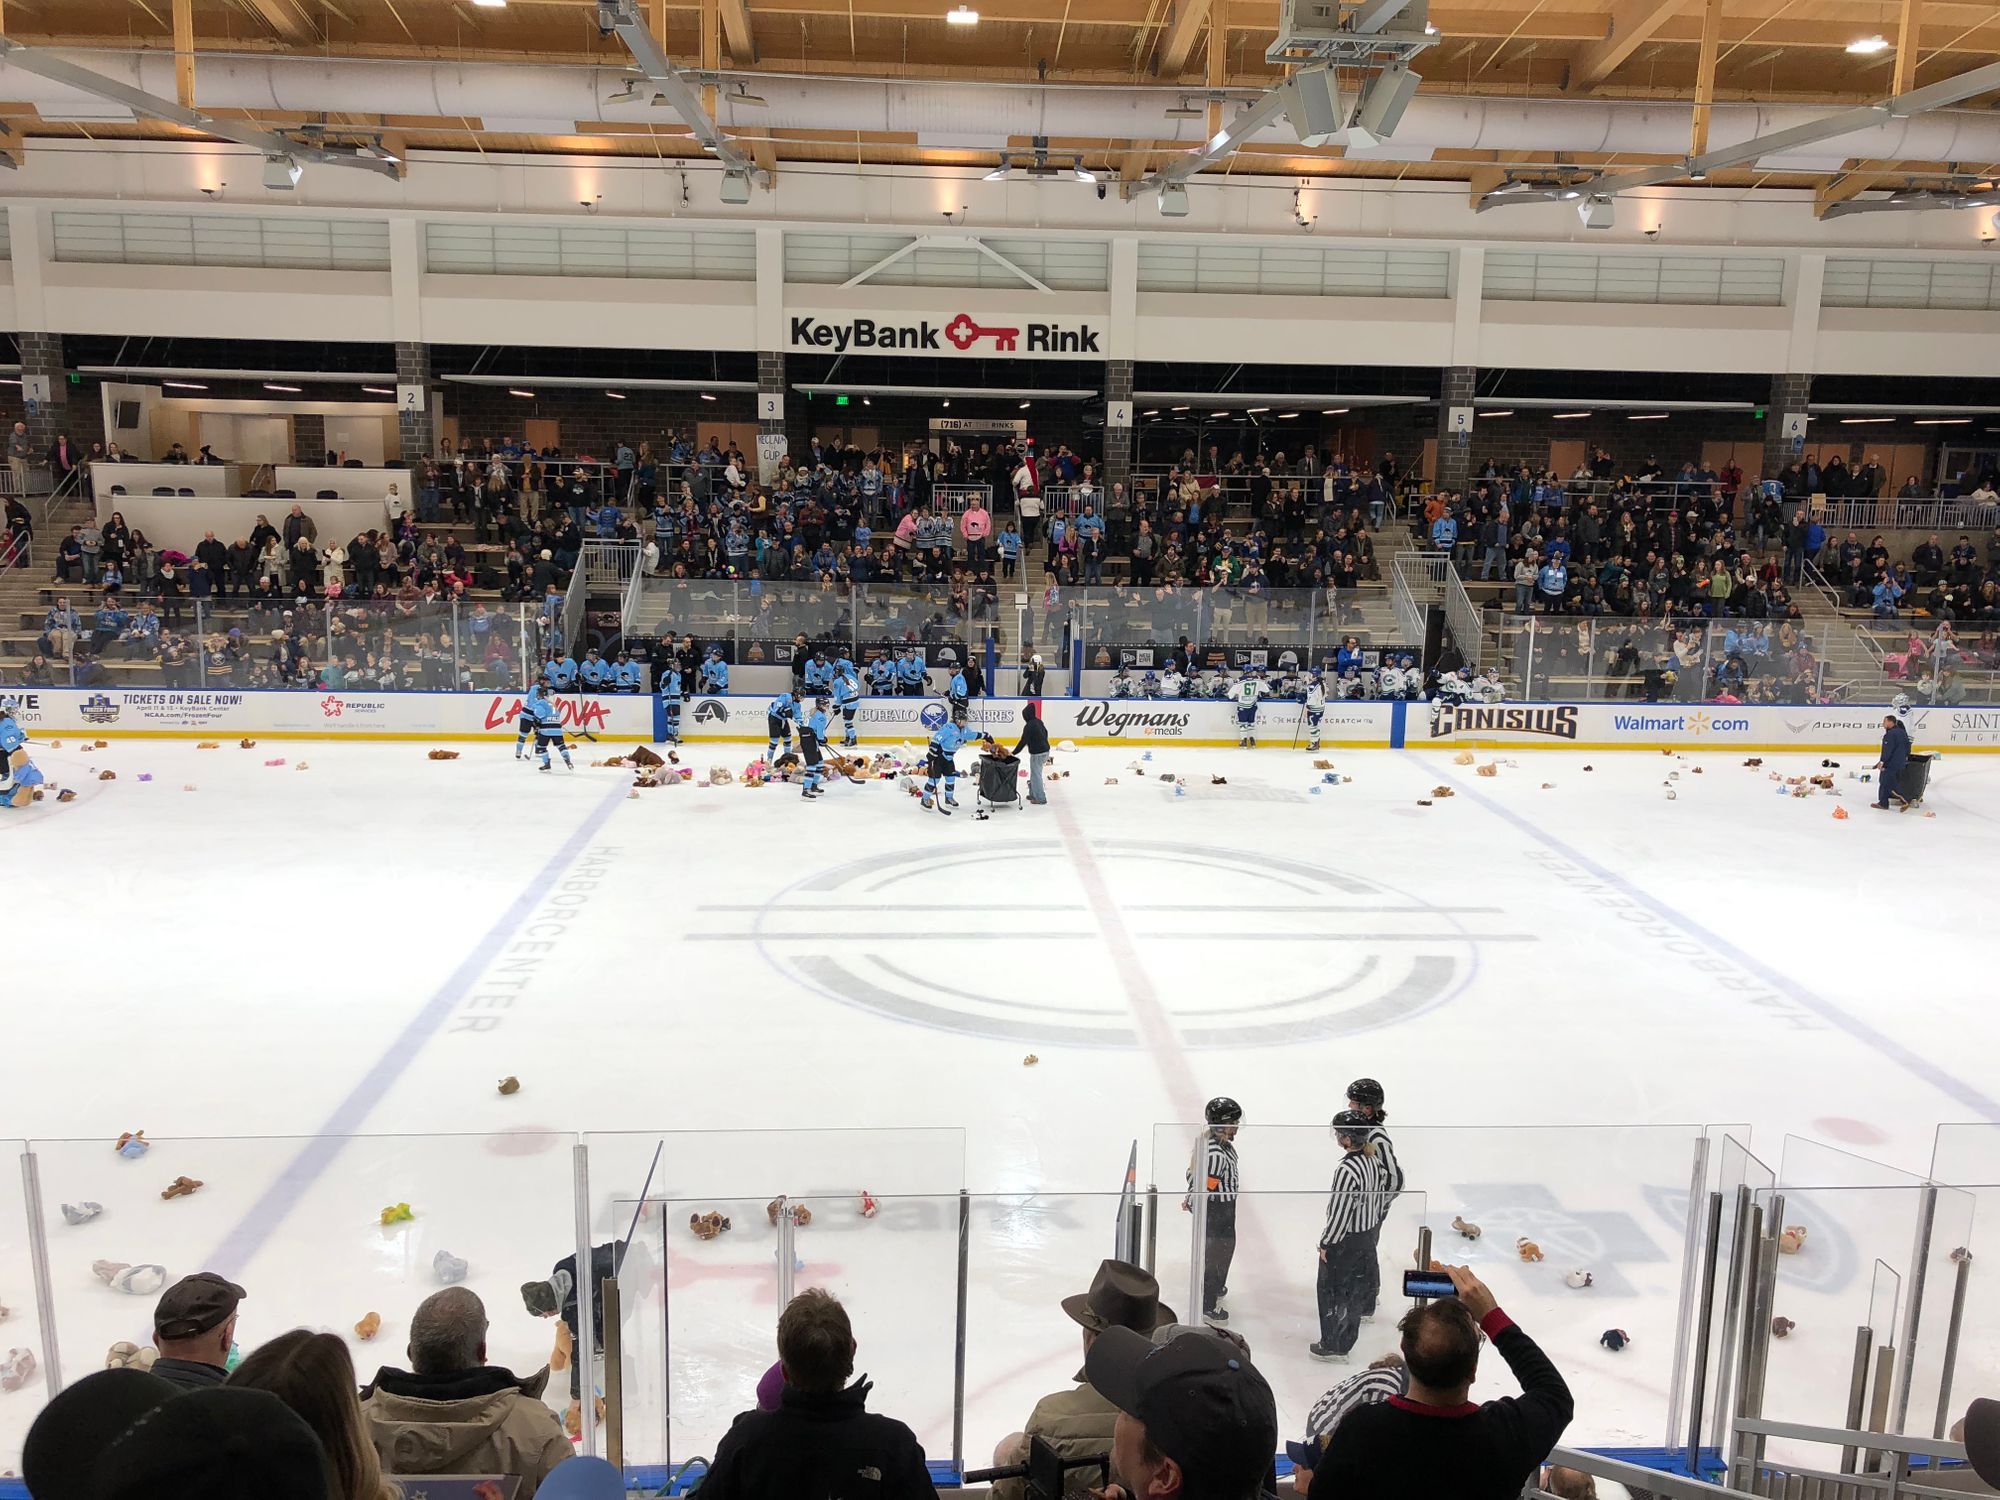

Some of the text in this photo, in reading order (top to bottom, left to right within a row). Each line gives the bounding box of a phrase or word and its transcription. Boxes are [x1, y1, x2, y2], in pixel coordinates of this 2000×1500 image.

[791, 317, 1100, 352] KeyBank Rink
[32, 383, 39, 395] 1
[407, 392, 415, 404] 2
[767, 401, 775, 412] 3
[1116, 408, 1124, 419] 4
[1457, 414, 1464, 425] 5
[940, 420, 961, 429] (716)
[1791, 420, 1798, 431] 6
[764, 449, 780, 461] CUP
[1769, 482, 1777, 495] 3
[1243, 682, 1258, 696] 67
[123, 694, 243, 705] TICKETS ON SALE NOW!
[858, 708, 1015, 724] BUFFALO SABRES
[1074, 701, 1190, 737] Wegmans
[1431, 704, 1579, 740] CANISIUS
[1614, 715, 1749, 731] Walmart com
[1812, 721, 1862, 733] ADPRO
[1154, 727, 1183, 736] meals
[448, 846, 624, 1034] HARBORCENTER
[1523, 850, 1829, 1031] HARBORCENTER
